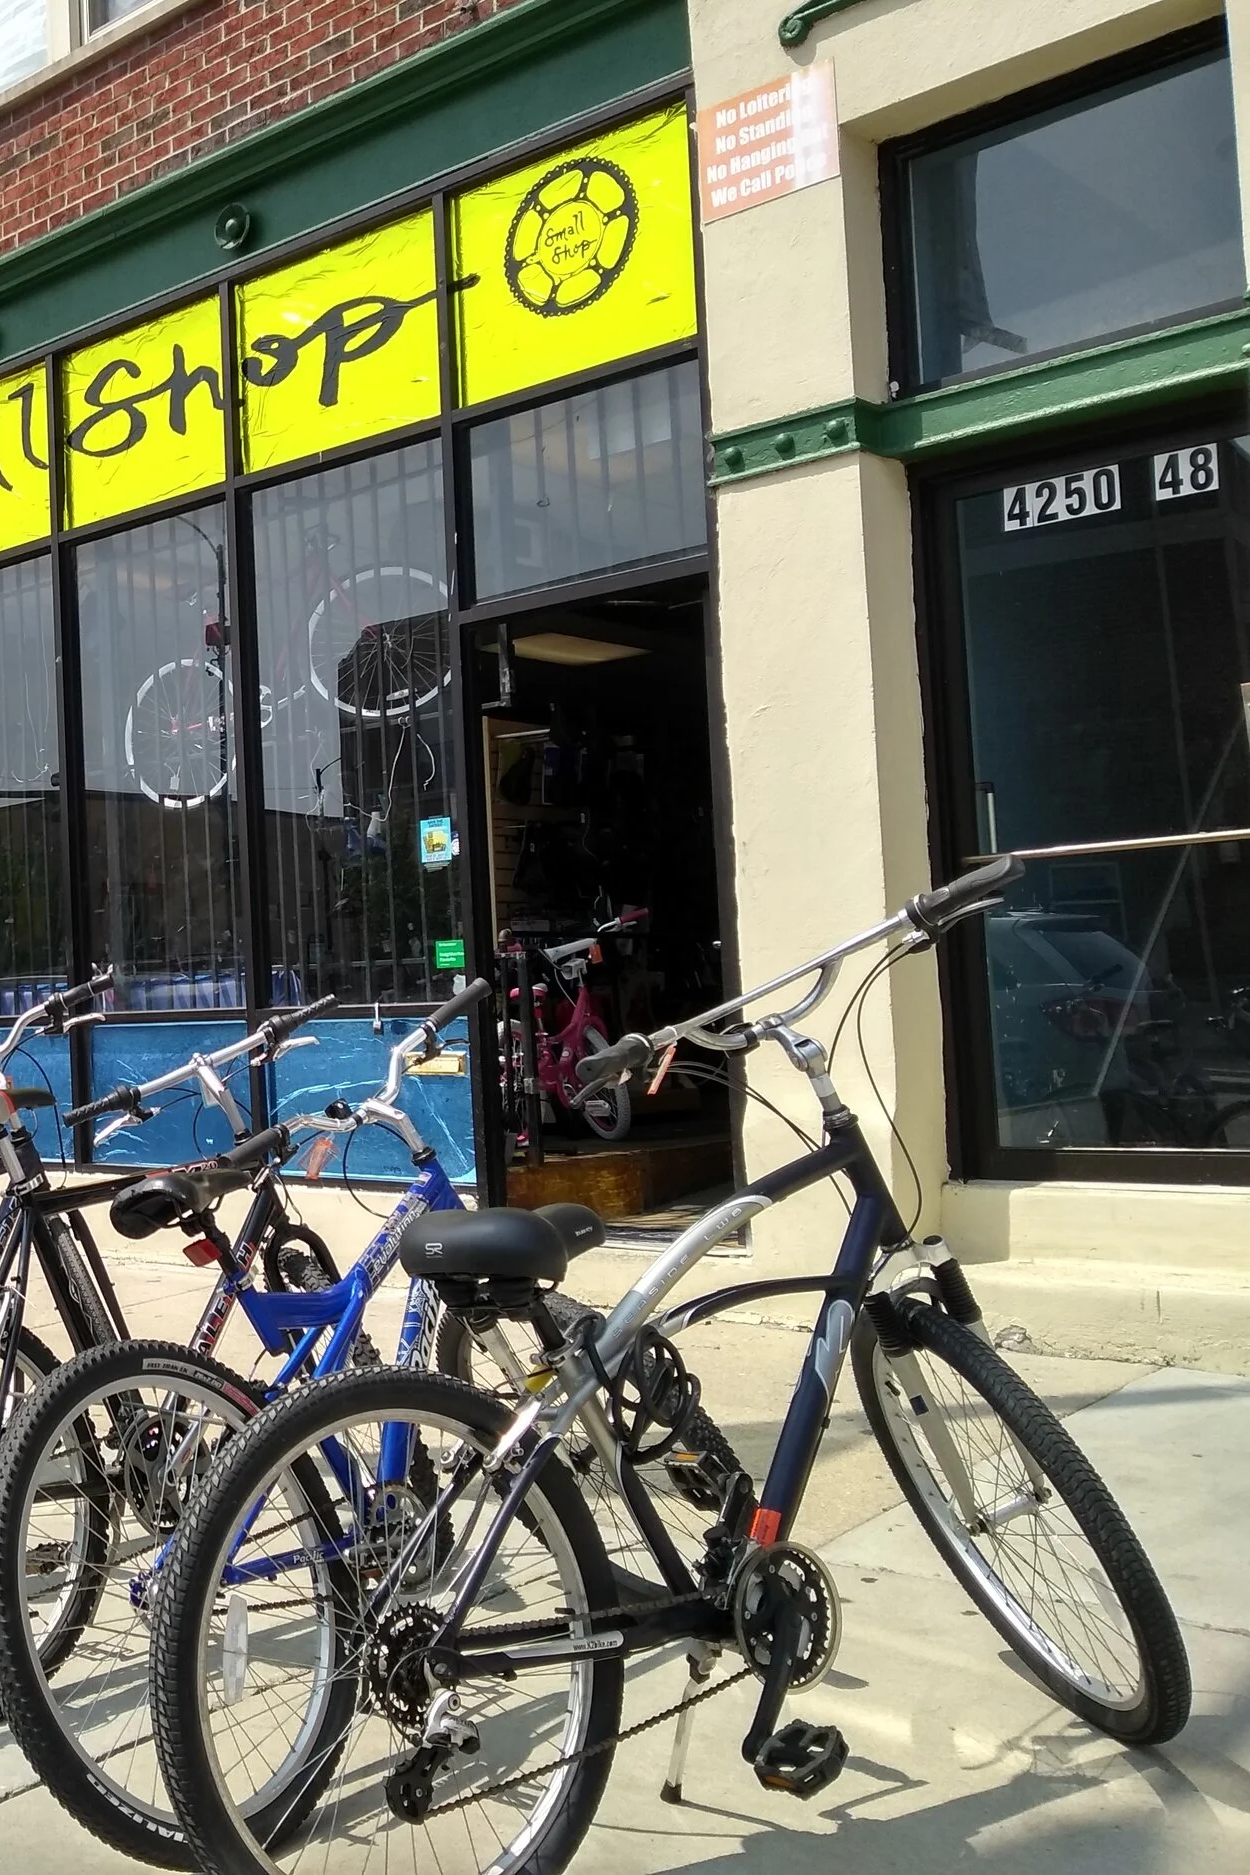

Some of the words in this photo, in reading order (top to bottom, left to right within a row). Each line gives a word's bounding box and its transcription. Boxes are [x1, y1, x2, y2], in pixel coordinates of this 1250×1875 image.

[715, 109, 737, 128] No
[740, 79, 812, 119] Loiterig
[715, 134, 737, 155] No
[739, 105, 816, 145] Standig
[707, 164, 728, 184] No
[711, 187, 738, 208] We
[740, 170, 772, 197] Call
[545, 211, 585, 247] Small
[552, 239, 598, 264] Shop
[66, 275, 479, 459] Shop
[1007, 468, 1117, 527] 4250
[1159, 447, 1214, 496] 48
[293, 1550, 324, 1564] Pacfic
